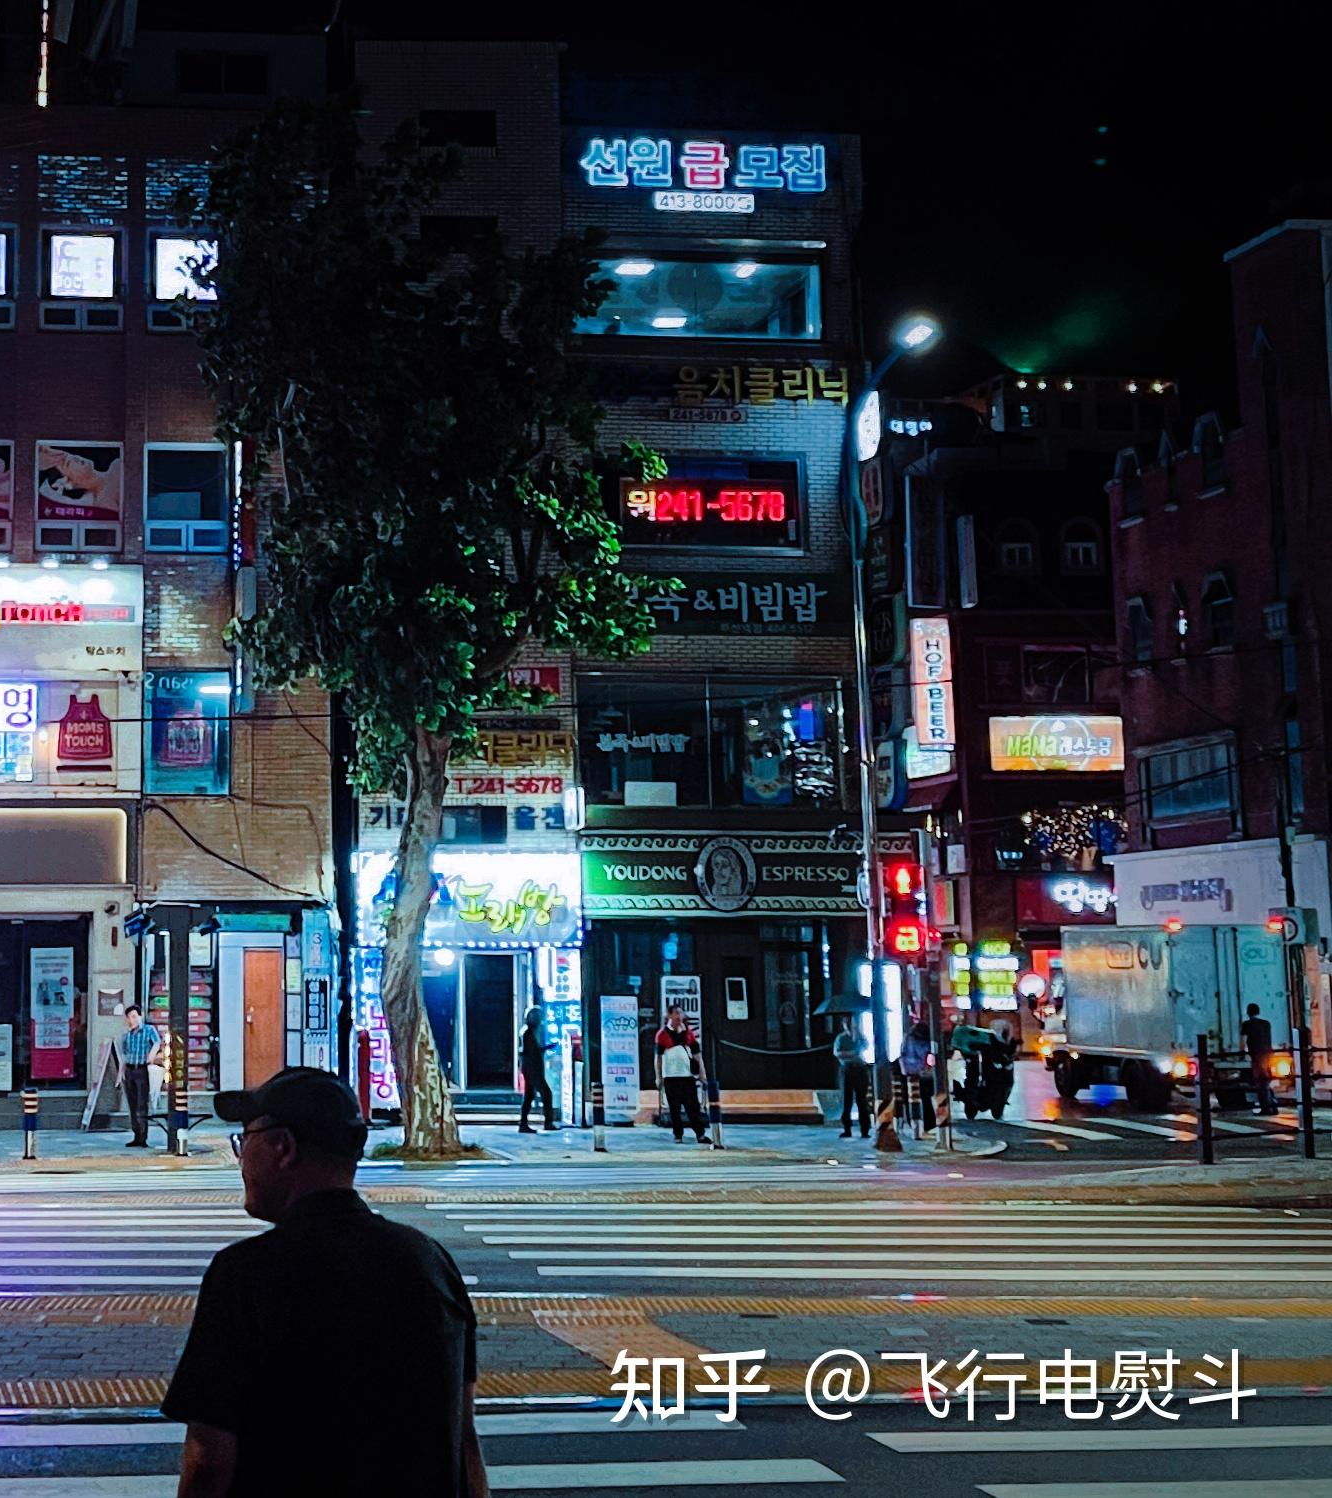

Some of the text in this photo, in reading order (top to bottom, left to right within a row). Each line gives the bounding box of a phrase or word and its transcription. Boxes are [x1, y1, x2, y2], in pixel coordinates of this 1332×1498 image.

[579, 137, 827, 192] 선원 급 모집
[673, 365, 850, 407] 음치클리닉
[925, 639, 947, 740] HOF BEER
[64, 734, 105, 747] TOUCH
[603, 864, 850, 882] YOUDONG ESPRESSO
[1136, 941, 1162, 971] CU
